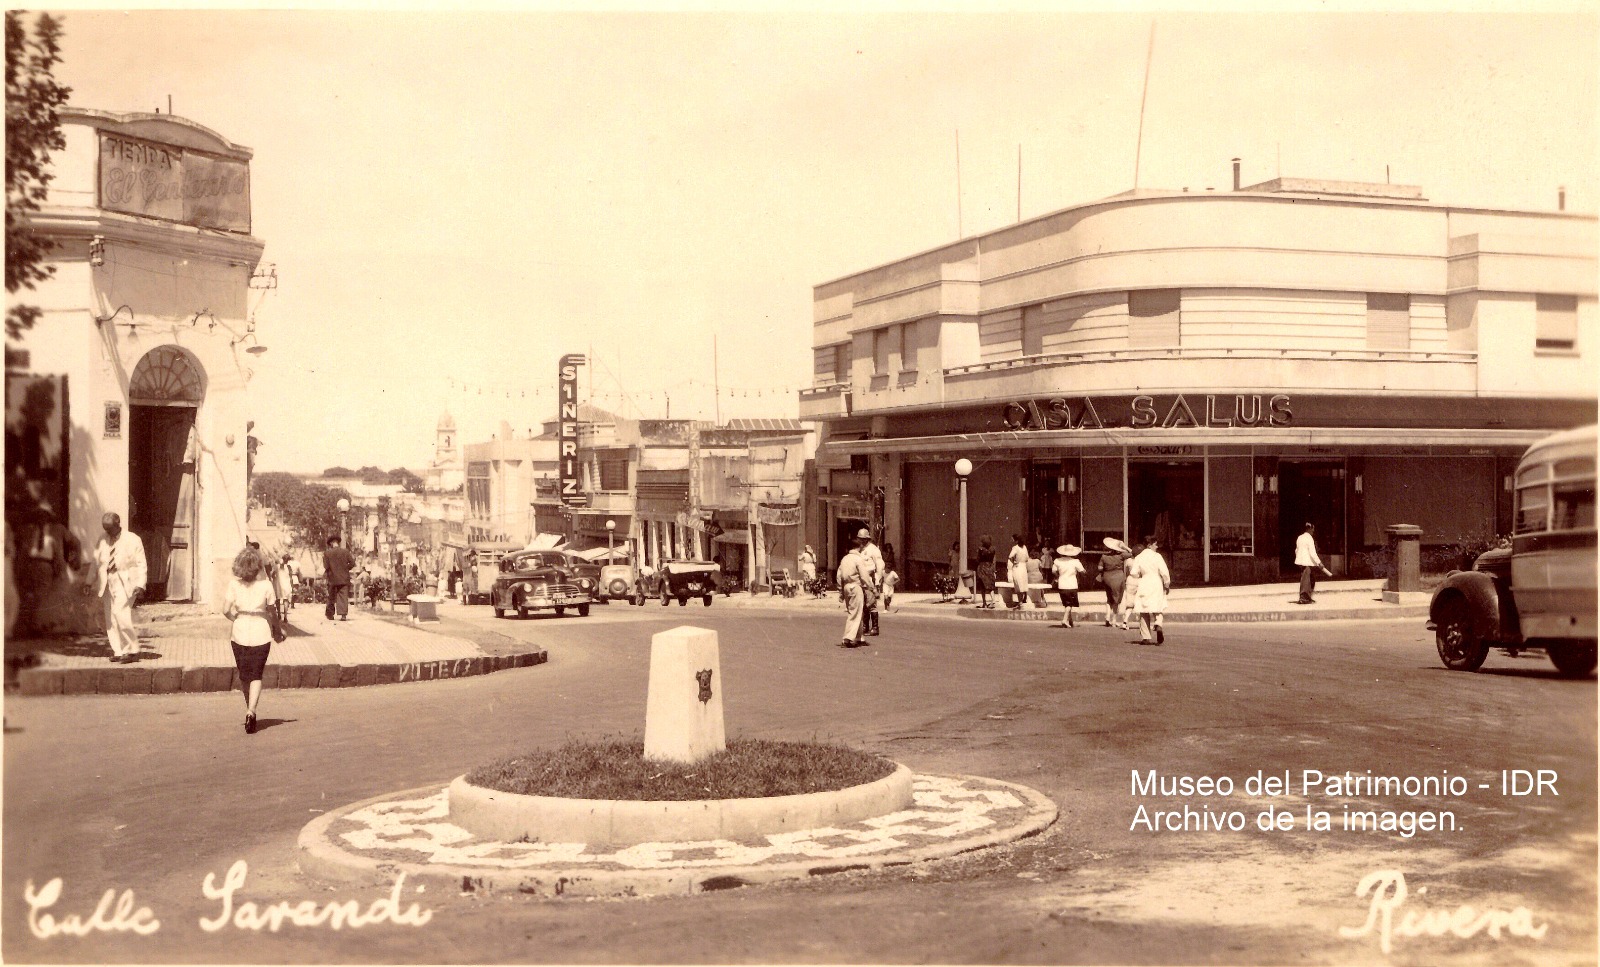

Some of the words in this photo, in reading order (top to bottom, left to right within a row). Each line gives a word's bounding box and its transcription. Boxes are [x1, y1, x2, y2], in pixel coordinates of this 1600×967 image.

[107, 138, 172, 169] TIENDA
[105, 167, 137, 203] El
[1002, 396, 1104, 429] CASA
[1131, 394, 1293, 428] SALUS
